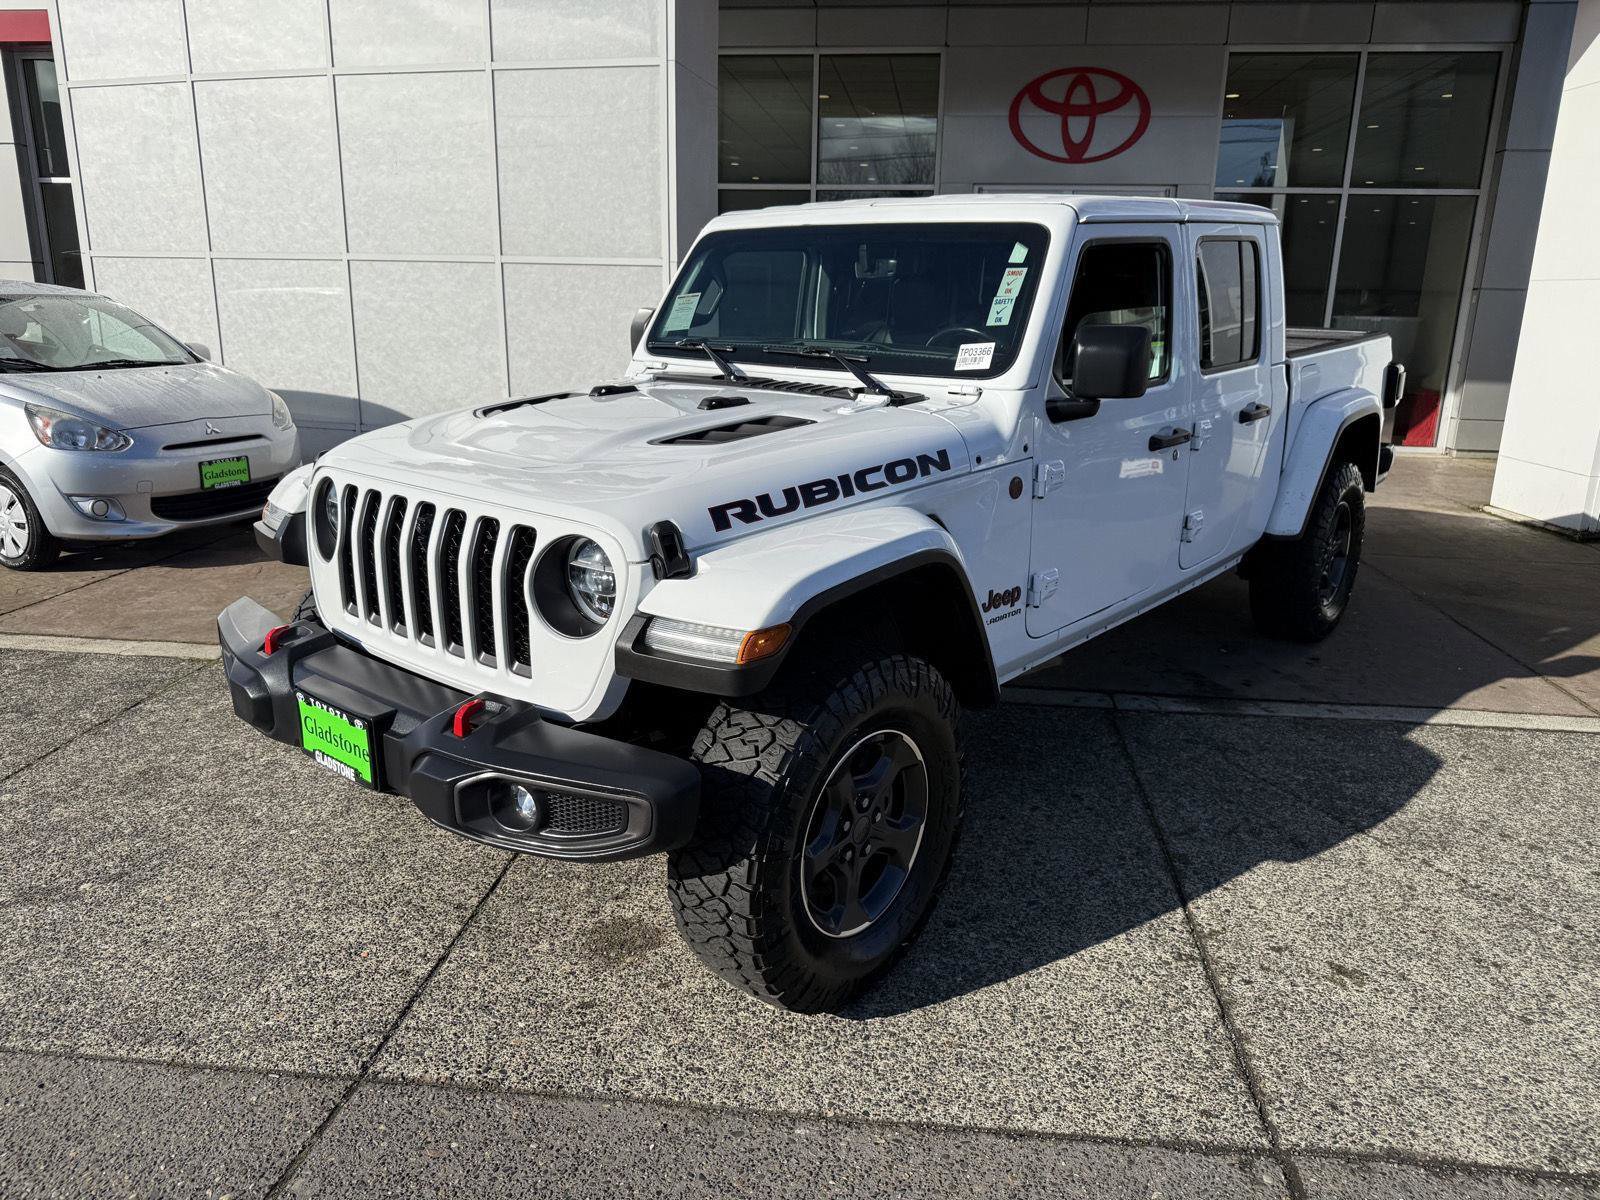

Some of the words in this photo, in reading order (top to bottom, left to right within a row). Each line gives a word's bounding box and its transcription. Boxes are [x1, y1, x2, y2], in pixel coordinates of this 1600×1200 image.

[994, 298, 1014, 306] SAFETY
[960, 346, 993, 357] TP03366
[212, 457, 238, 465] TOYOTA
[204, 468, 247, 481] Gladstone
[707, 448, 952, 533] RUBICON
[981, 586, 1022, 613] Jeep
[309, 697, 349, 722] TOYOTA
[303, 715, 369, 762] Gladstone
[314, 750, 356, 782] GLADSTONE
